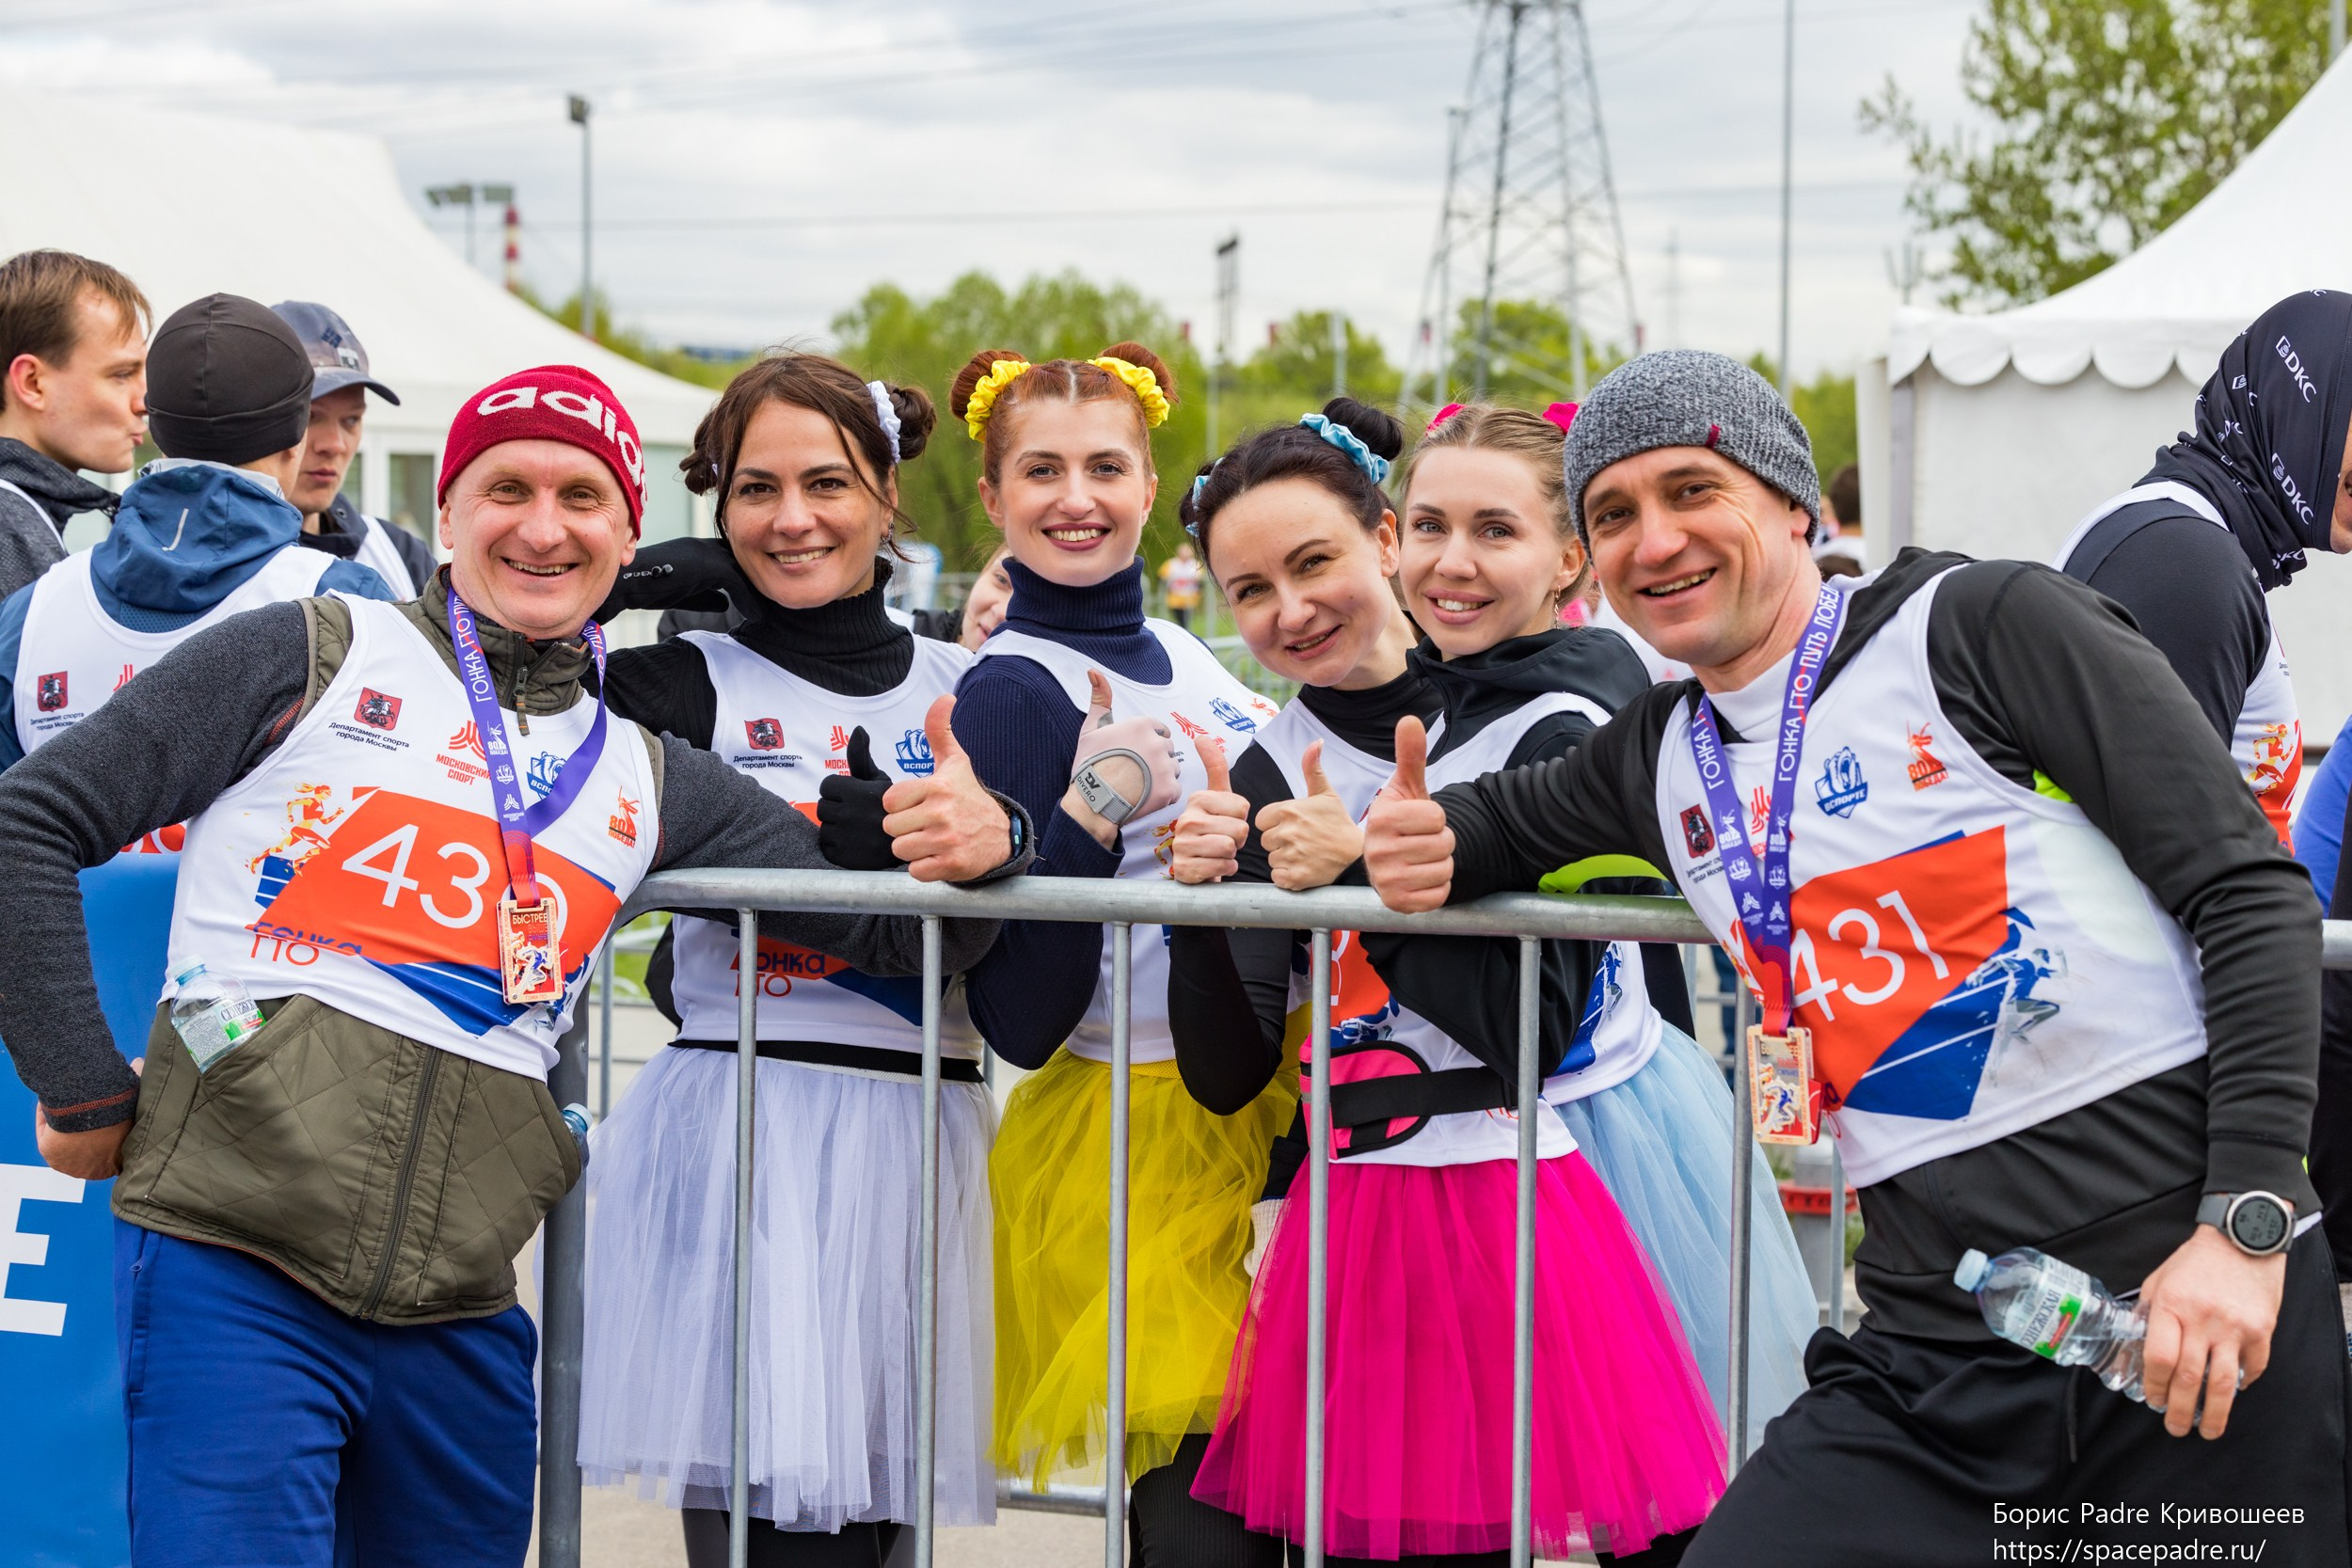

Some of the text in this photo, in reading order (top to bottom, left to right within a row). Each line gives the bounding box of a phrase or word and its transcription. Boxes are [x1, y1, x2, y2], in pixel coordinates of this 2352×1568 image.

[2284, 351, 2317, 403] DKC
[2281, 475, 2314, 525] DKC
[454, 594, 492, 703] ГОНКА ГТО ПУТ
[1799, 632, 1828, 668] ПУТЬ
[1788, 673, 1812, 709] ГТО
[329, 721, 410, 748] Департамент спорта
[335, 730, 397, 752] города Москвы
[733, 754, 779, 764] Департамент
[1693, 727, 1725, 790] ГОНКА
[1778, 717, 1803, 782] ГОНКА
[447, 769, 476, 786] СПОРТ
[1907, 760, 1929, 780] 80
[1076, 776, 1097, 803] DIVERO
[1824, 788, 1866, 812] ВСПОРТЕ
[609, 815, 627, 832] 80
[608, 829, 636, 848] ПОБЕДА!
[251, 934, 319, 966] ГТО
[1794, 890, 1950, 1022] 431
